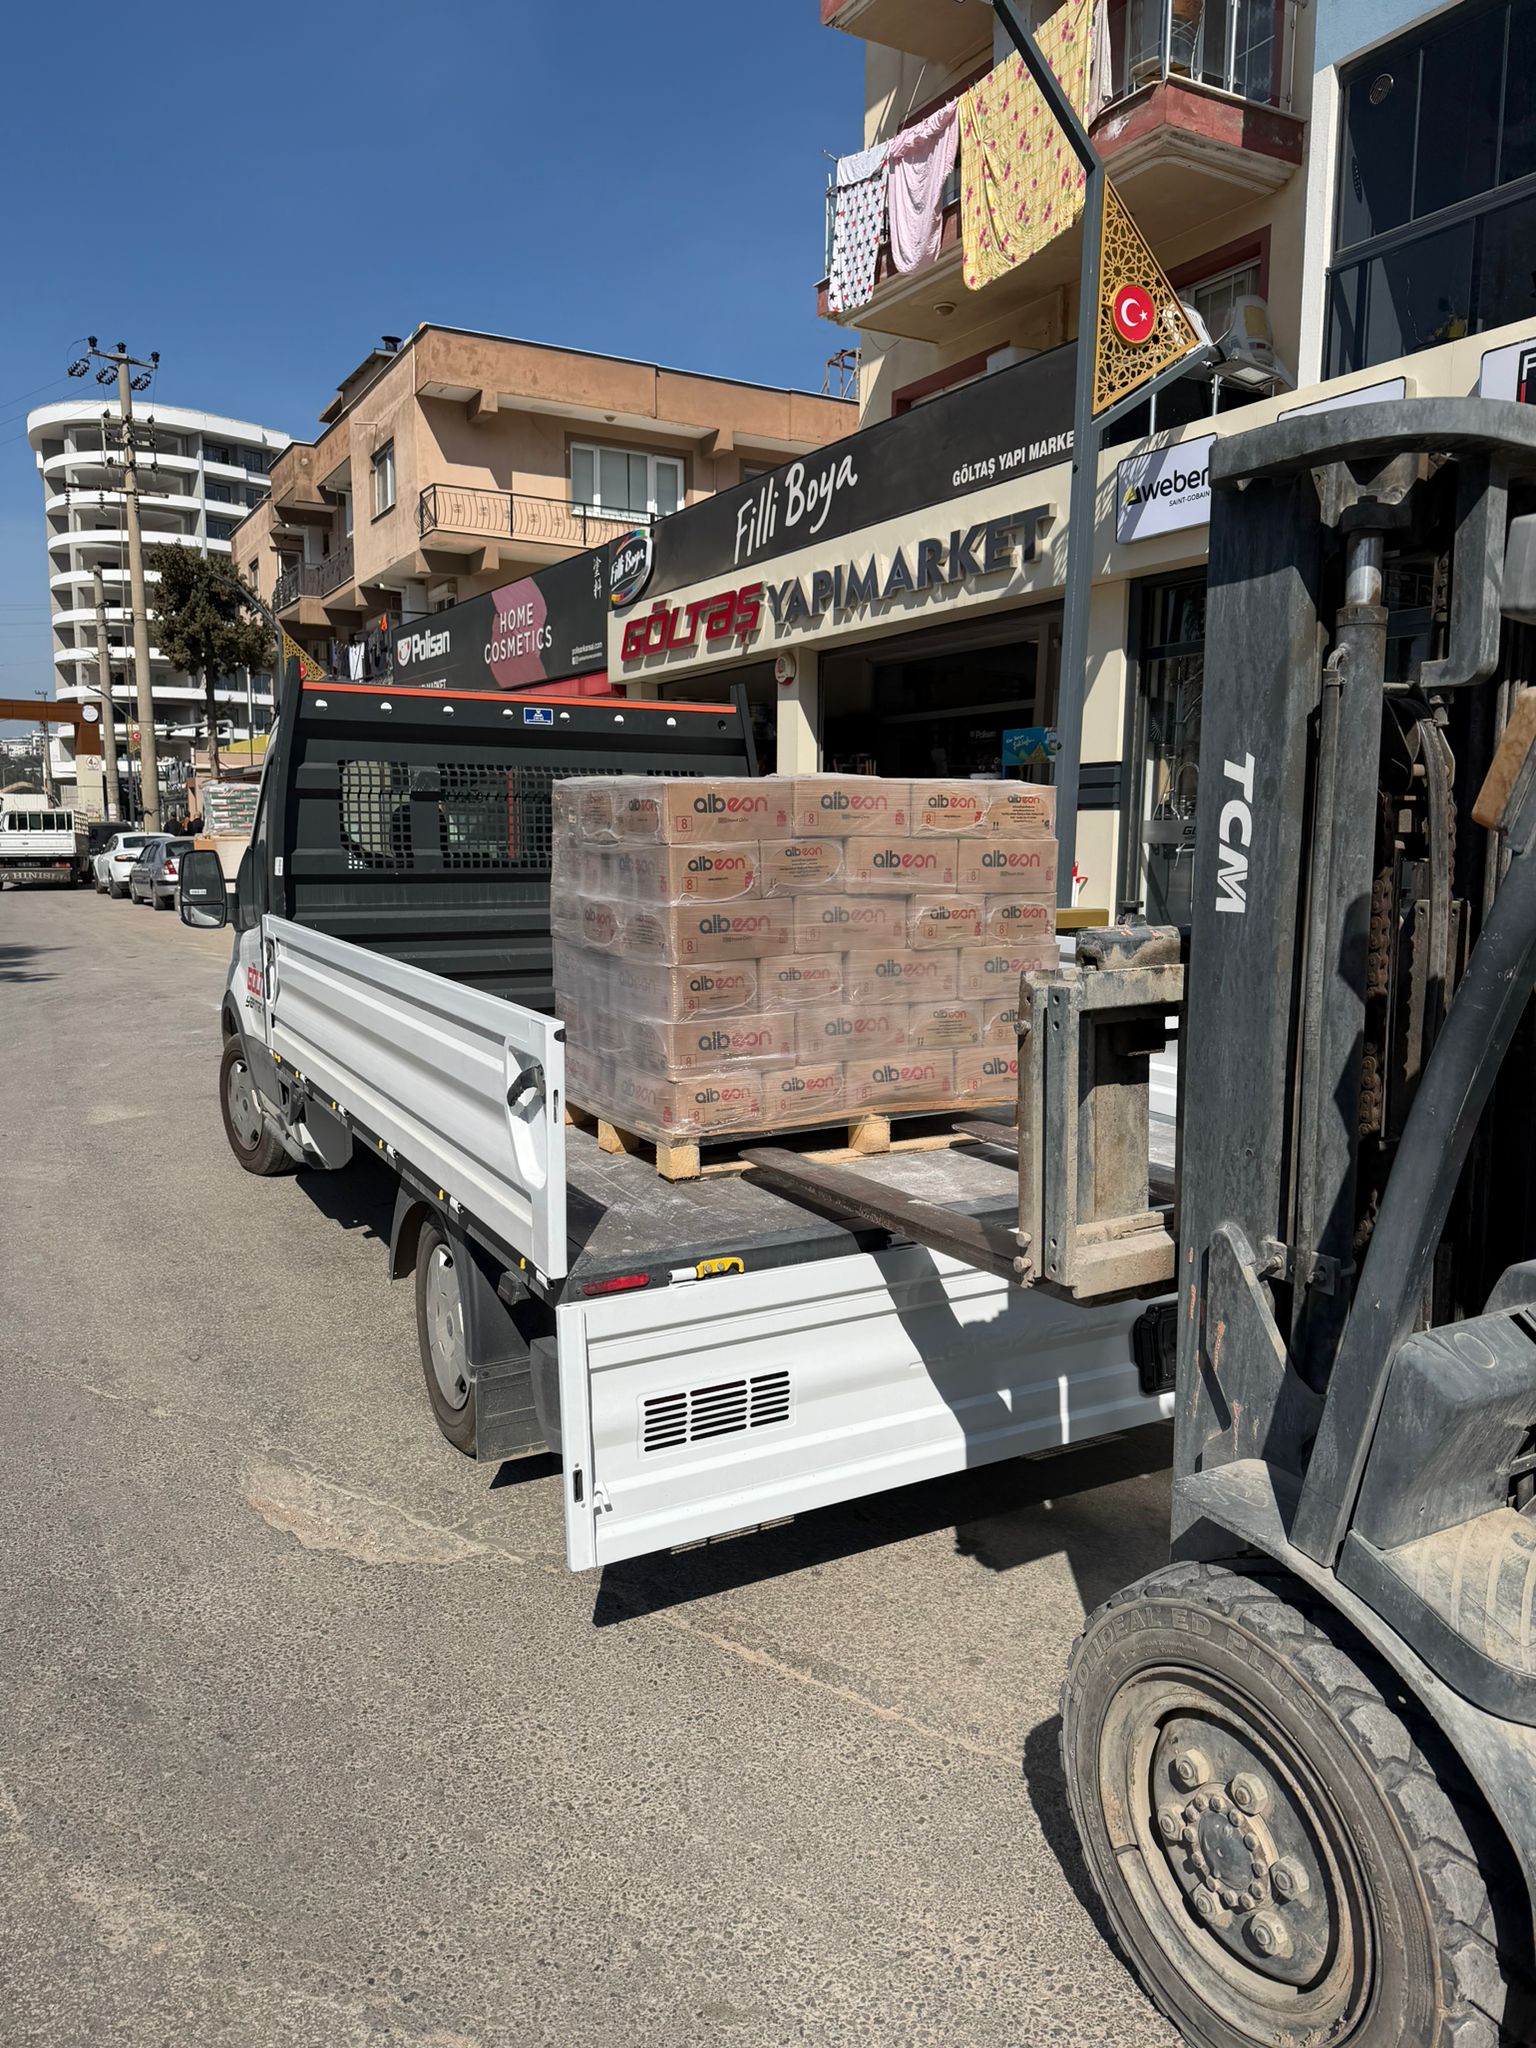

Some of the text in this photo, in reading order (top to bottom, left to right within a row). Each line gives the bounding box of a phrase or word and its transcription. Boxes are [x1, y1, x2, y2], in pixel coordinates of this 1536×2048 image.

[952, 430, 1075, 487] GÖLTAŞ YAPI MARKE
[1142, 466, 1209, 502] weber
[1168, 490, 1210, 507] SAINT-GOBAIN
[734, 454, 858, 565] Filli Boya
[610, 549, 645, 585] Filli Boya
[767, 502, 1057, 625] YAPIMARKET
[500, 603, 534, 634] HOME
[411, 629, 450, 664] Polisan
[484, 625, 552, 665] COSMETICS
[694, 794, 768, 814] albeon
[820, 791, 888, 810] albeon
[928, 794, 976, 808] albeon
[681, 819, 687, 830] 8
[808, 814, 814, 824] 8
[926, 814, 932, 824] 8
[1216, 751, 1256, 913] TCM
[784, 846, 822, 857] albeon
[873, 850, 937, 869] albeon
[981, 850, 1040, 868] albeon
[688, 856, 745, 872] albeon
[686, 880, 693, 890] 8
[822, 906, 886, 924] albeon
[930, 906, 976, 920] albeon
[1001, 904, 1047, 920] albeon
[699, 914, 771, 935] albeon
[687, 940, 693, 951] 8
[875, 960, 937, 978] albeon
[984, 956, 1042, 974] albeon
[690, 975, 744, 992] albeon
[778, 967, 830, 982] albeon
[688, 999, 695, 1010] 8
[1000, 1008, 1018, 1023] alb
[824, 1016, 889, 1036] albeon
[698, 1030, 772, 1051] albeon
[872, 1065, 935, 1084] albeon
[982, 1058, 1018, 1076] albe
[782, 1076, 834, 1092] albeon
[972, 1080, 978, 1090] 8
[695, 1087, 750, 1104] albeon
[693, 1110, 700, 1121] 8
[1171, 1607, 1212, 1636] ED
[1226, 1628, 1317, 1719] PLUS
